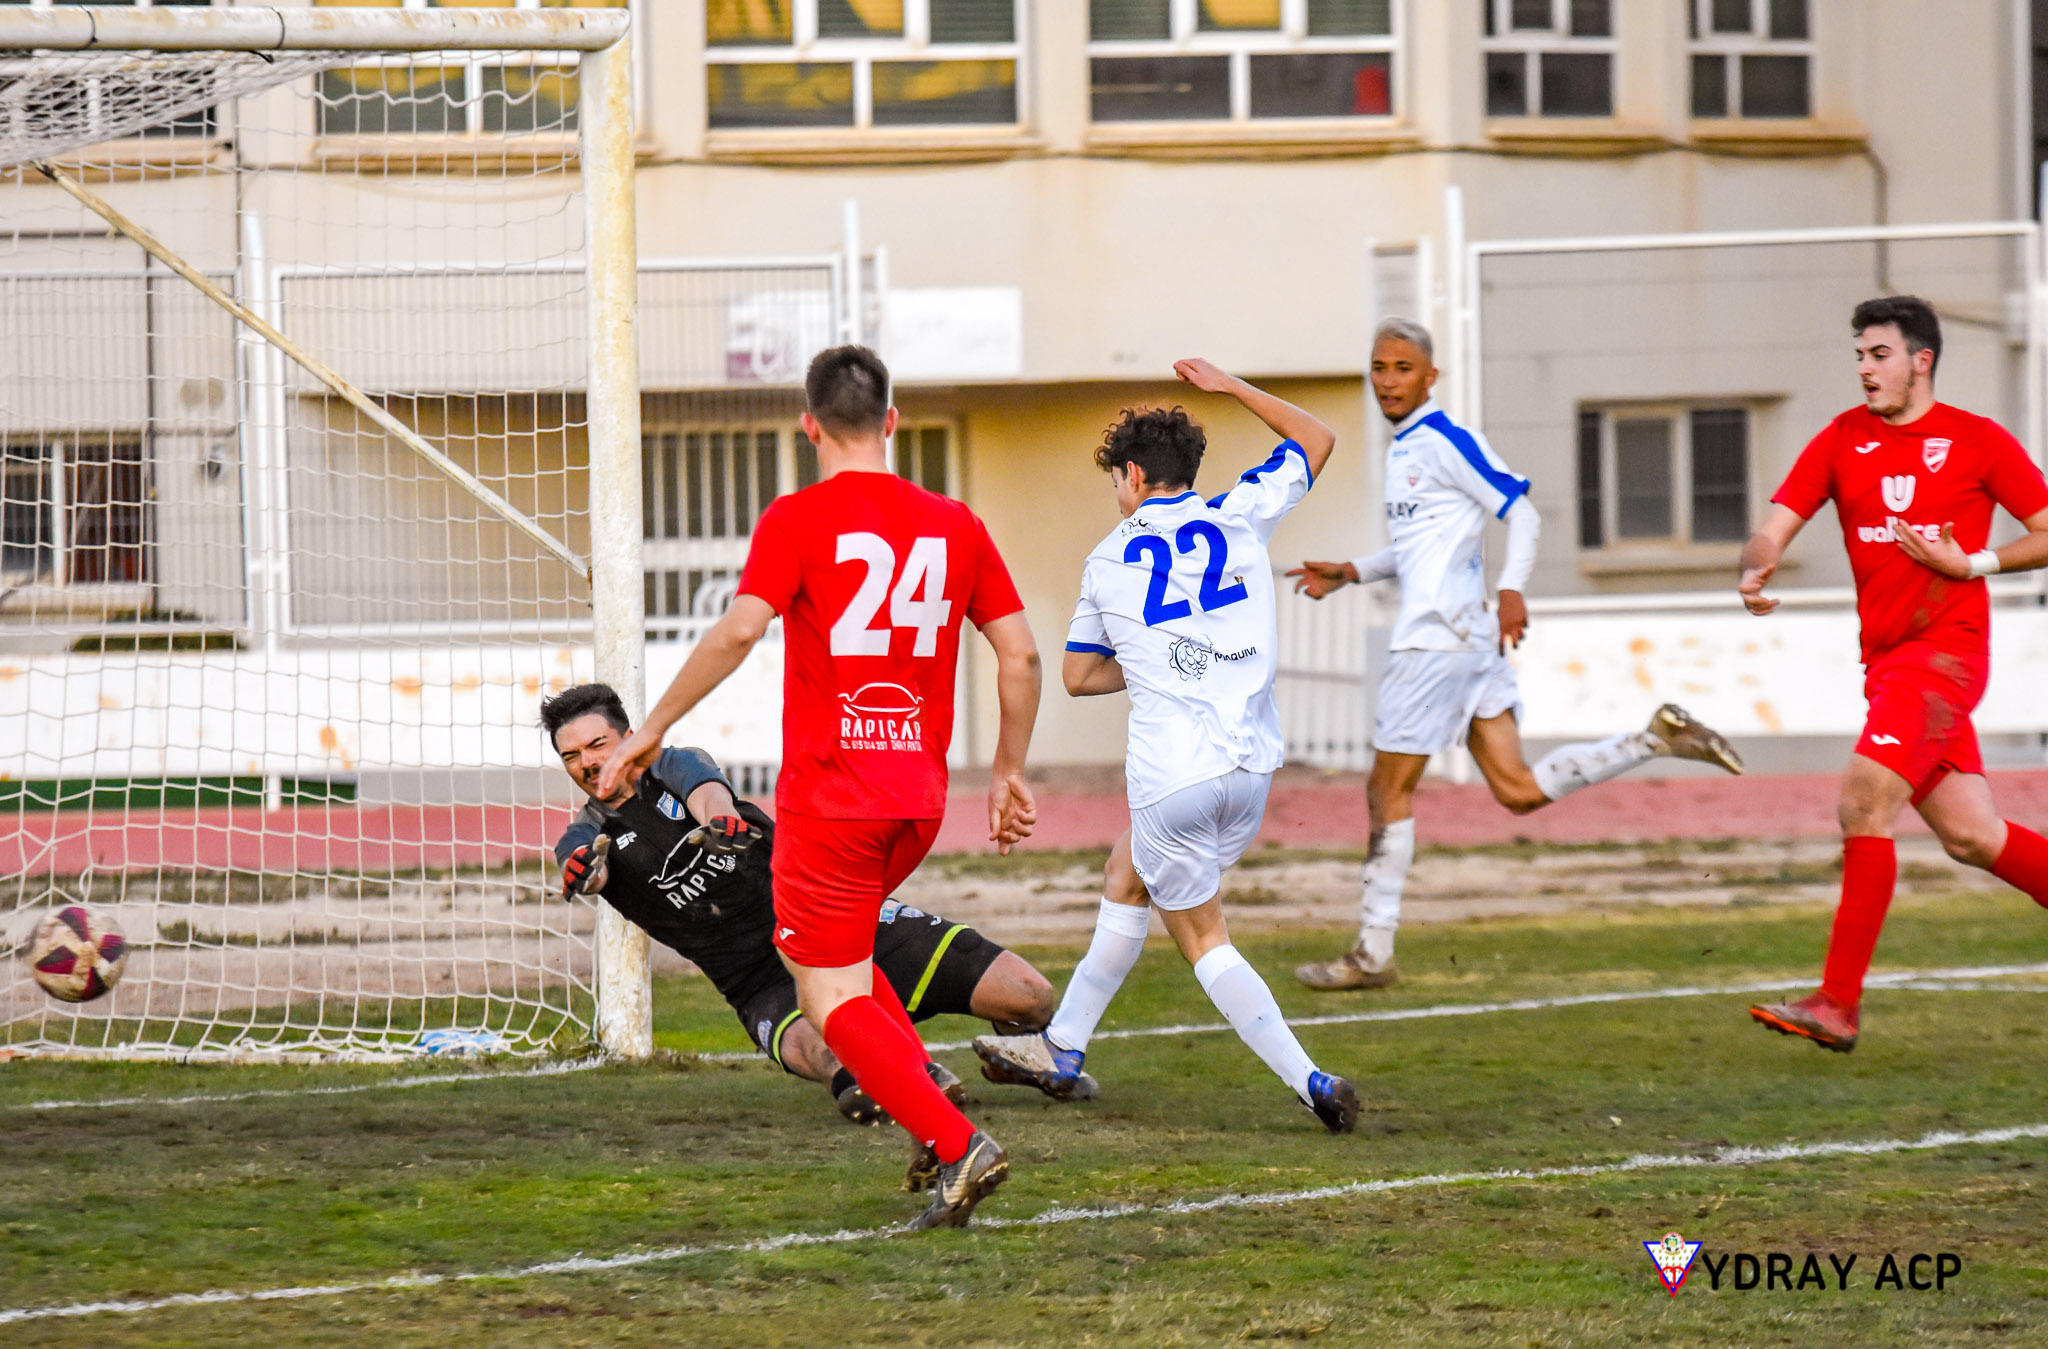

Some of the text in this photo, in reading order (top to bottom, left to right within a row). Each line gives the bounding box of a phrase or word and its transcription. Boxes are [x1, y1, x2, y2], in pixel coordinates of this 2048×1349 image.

[830, 531, 952, 657] 24
[1123, 519, 1249, 627] 22
[841, 717, 921, 740] RAPICAR
[666, 854, 727, 909] RAPIC
